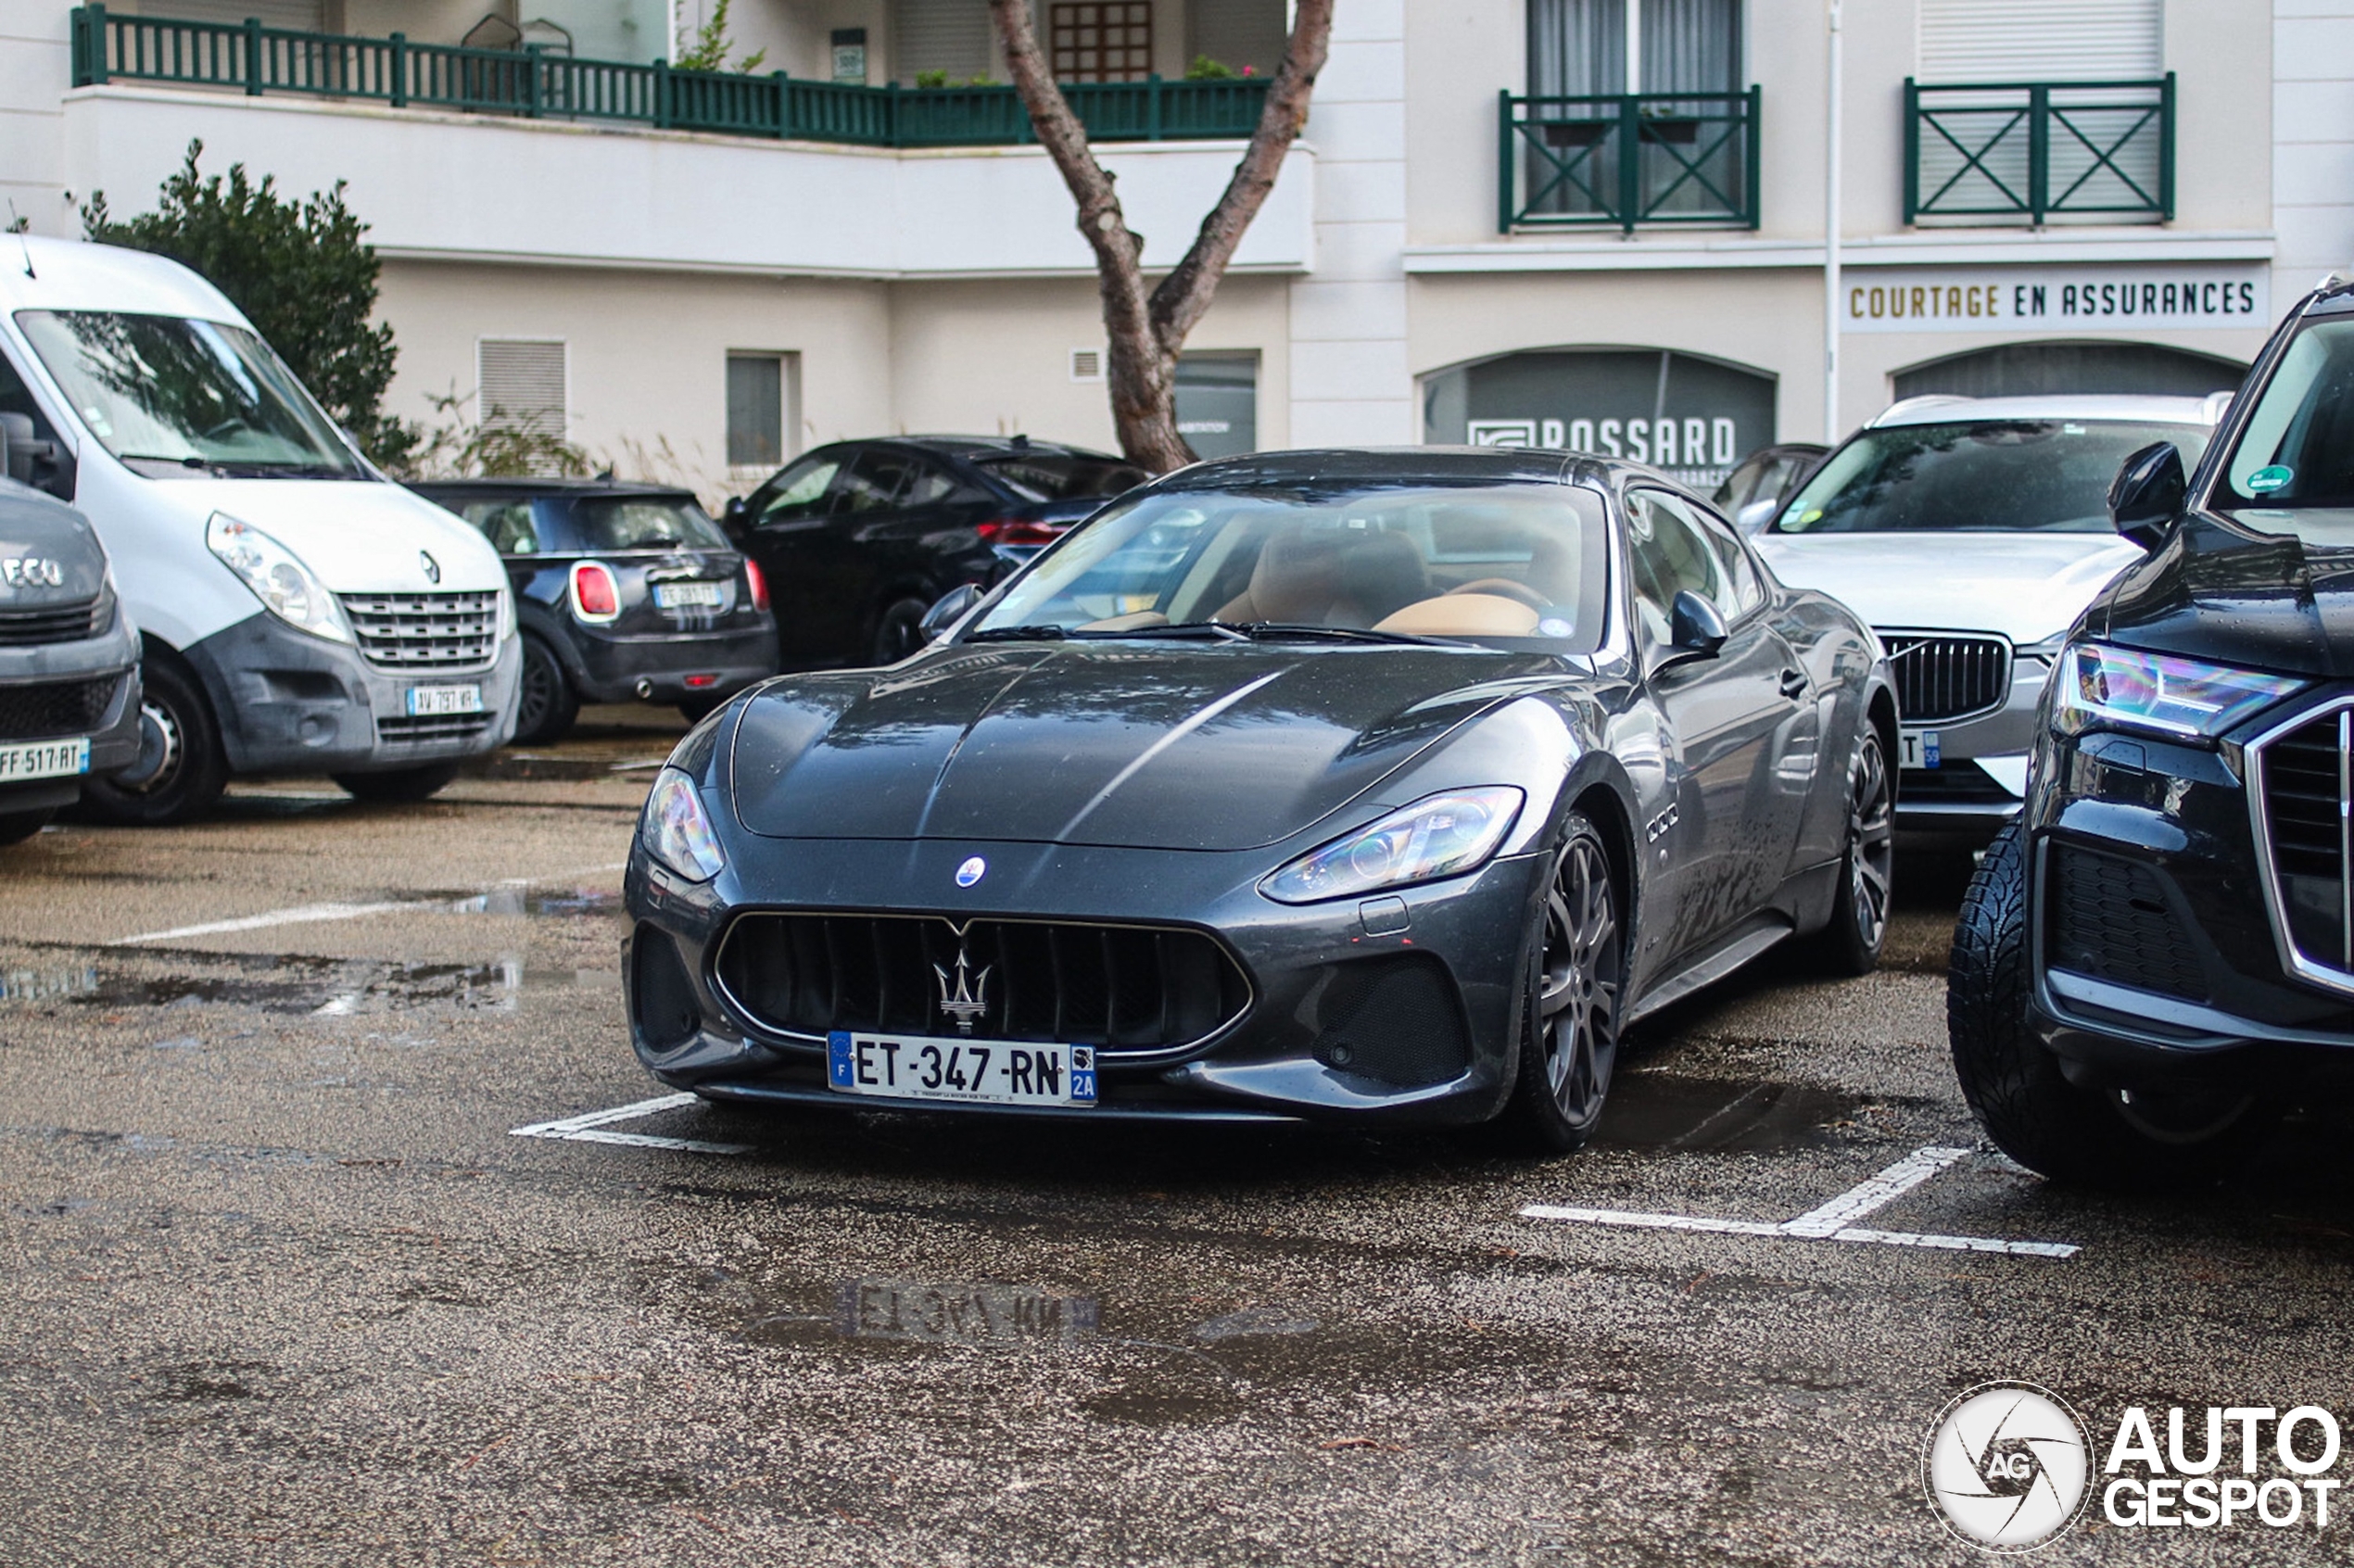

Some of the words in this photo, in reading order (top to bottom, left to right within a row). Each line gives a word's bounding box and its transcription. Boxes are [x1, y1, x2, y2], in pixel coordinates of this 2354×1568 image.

[1850, 285, 1998, 318] COURTAGE
[2014, 285, 2046, 317] EN
[2062, 282, 2254, 316] ASSURANCES
[0, 558, 63, 588] ECO
[1925, 749, 1941, 763] 59
[837, 1063, 846, 1077] F
[856, 1040, 1059, 1095] ET-347-RN
[1072, 1075, 1095, 1096] 2A
